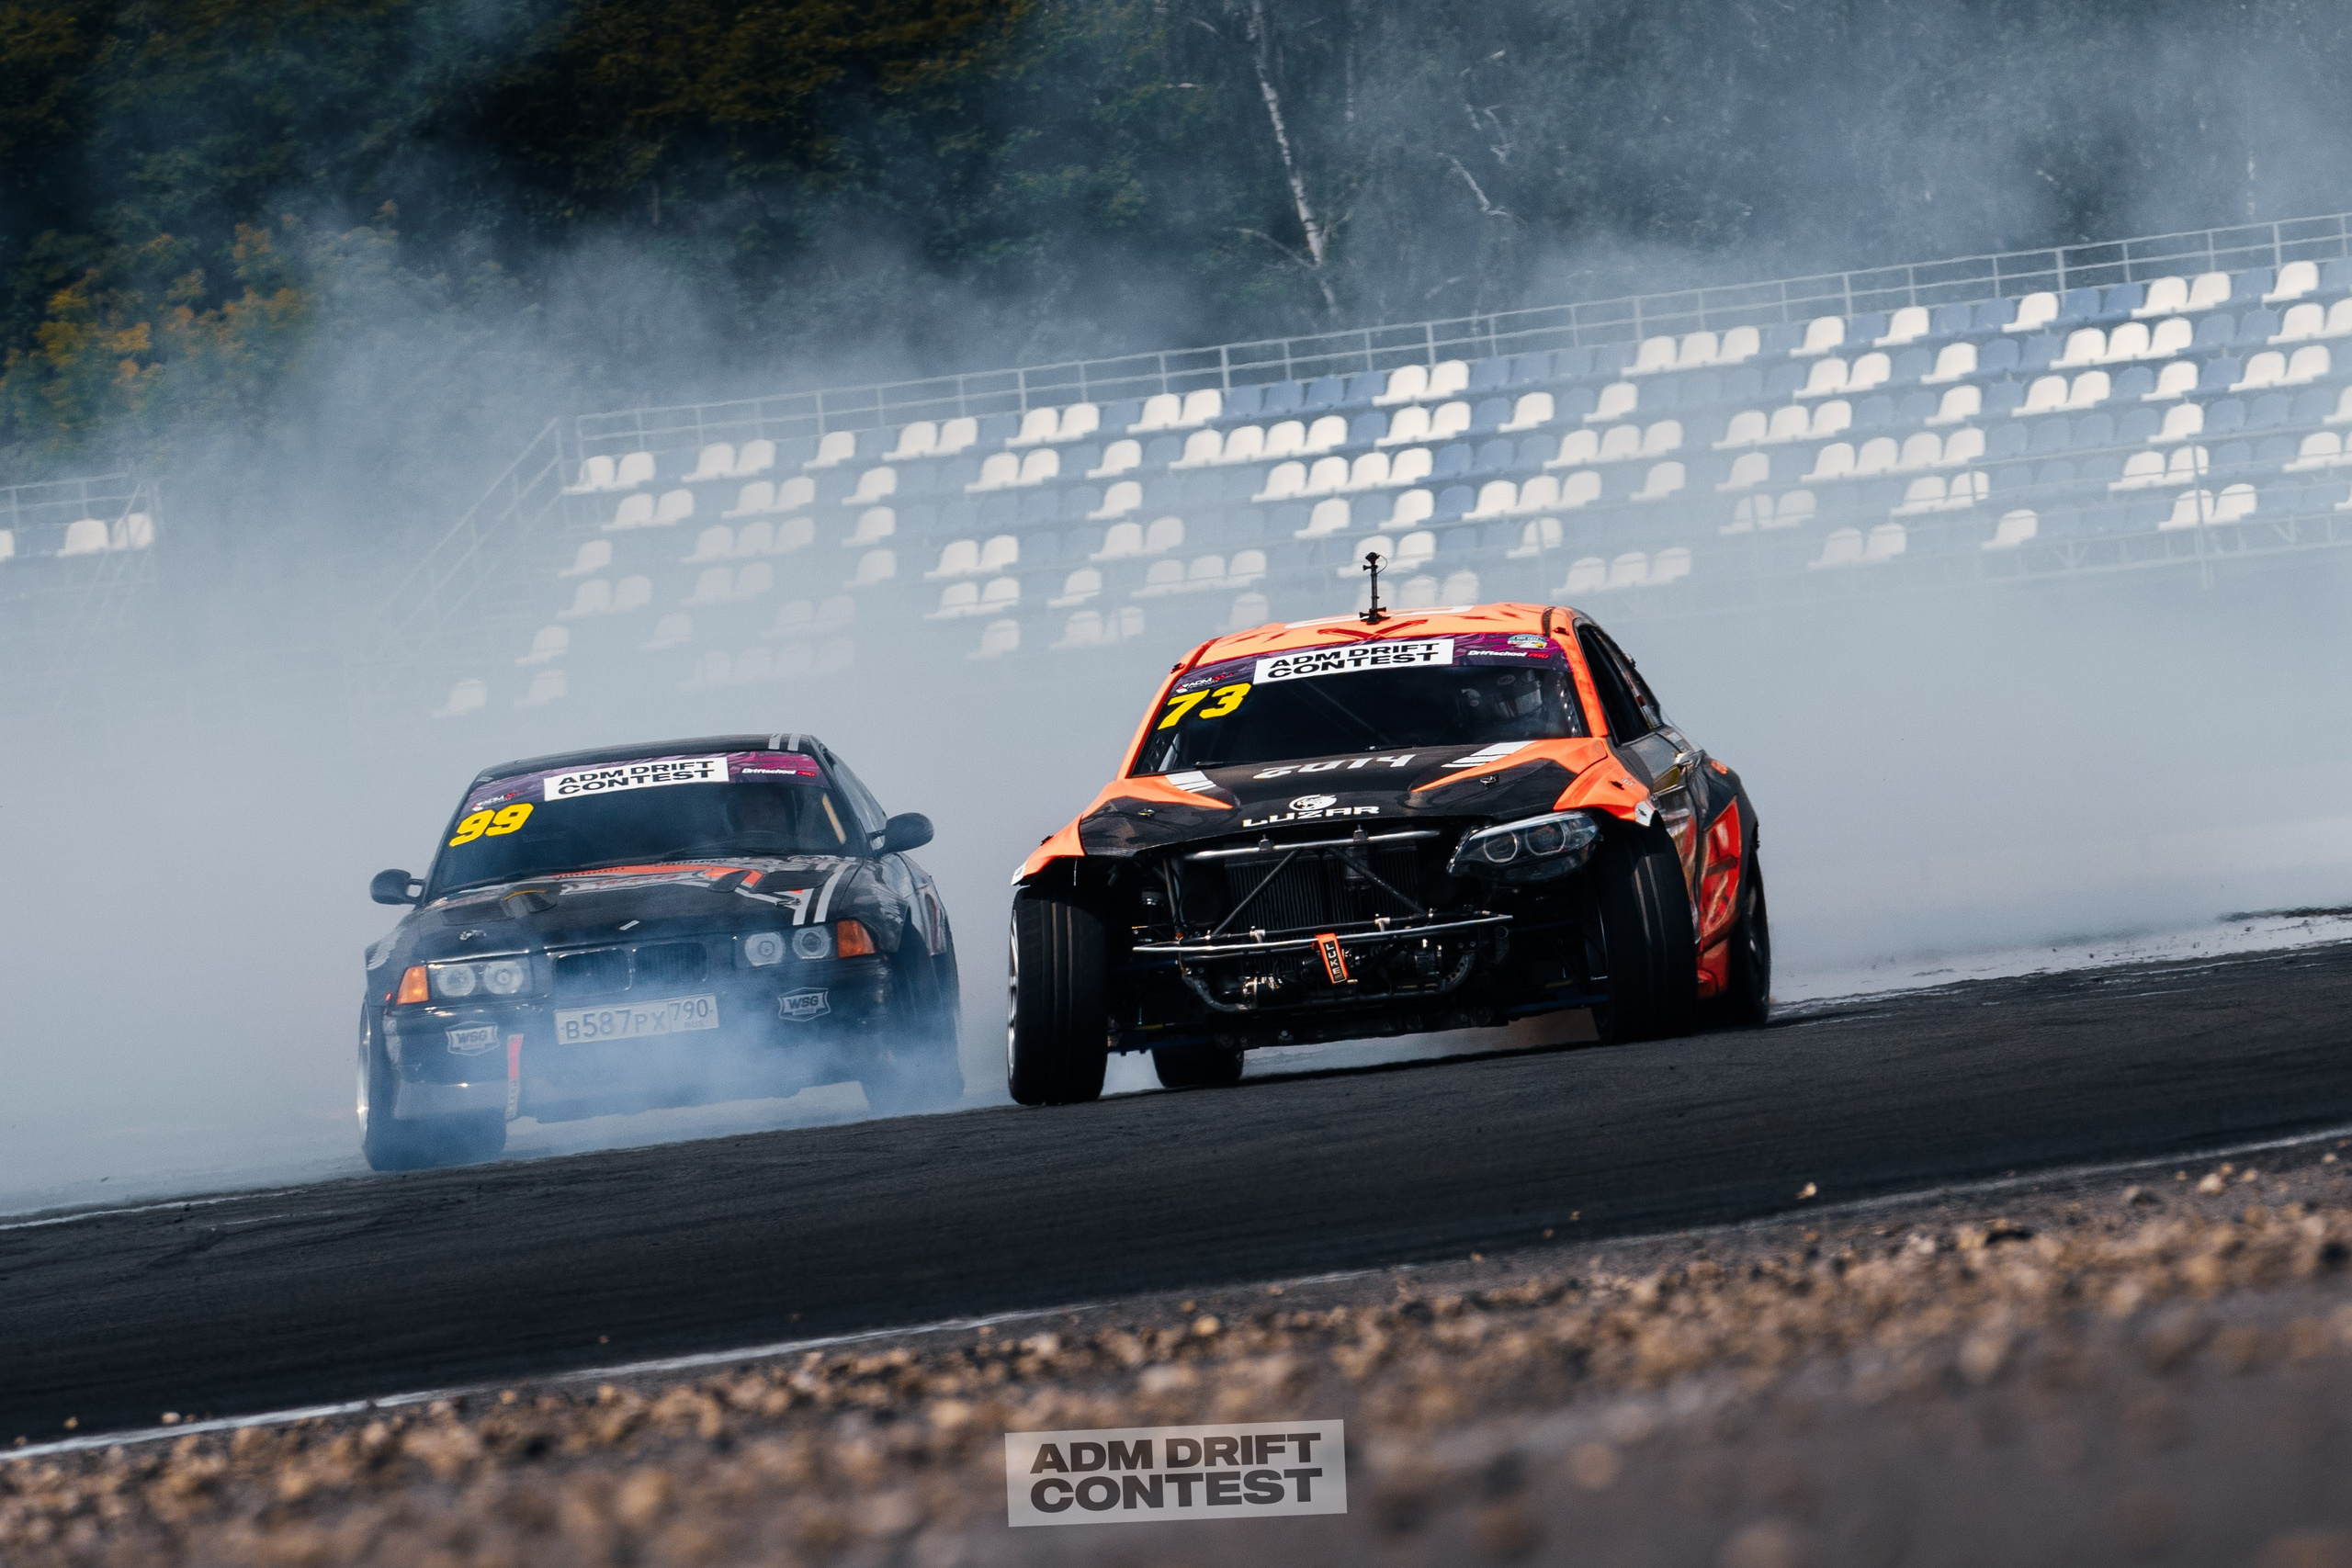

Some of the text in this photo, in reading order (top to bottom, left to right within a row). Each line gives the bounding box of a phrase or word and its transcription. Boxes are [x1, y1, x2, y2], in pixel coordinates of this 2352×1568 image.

[1267, 651, 1440, 679] CONTEST
[1270, 642, 1440, 669] ADM DRIFT
[1157, 682, 1252, 730] 73
[558, 761, 715, 786] ADM DRIFT
[558, 769, 715, 795] CONTEST
[449, 803, 534, 847] 99
[1242, 806, 1380, 828] LUZAR
[669, 998, 709, 1021] 790
[787, 995, 819, 1010] WSG
